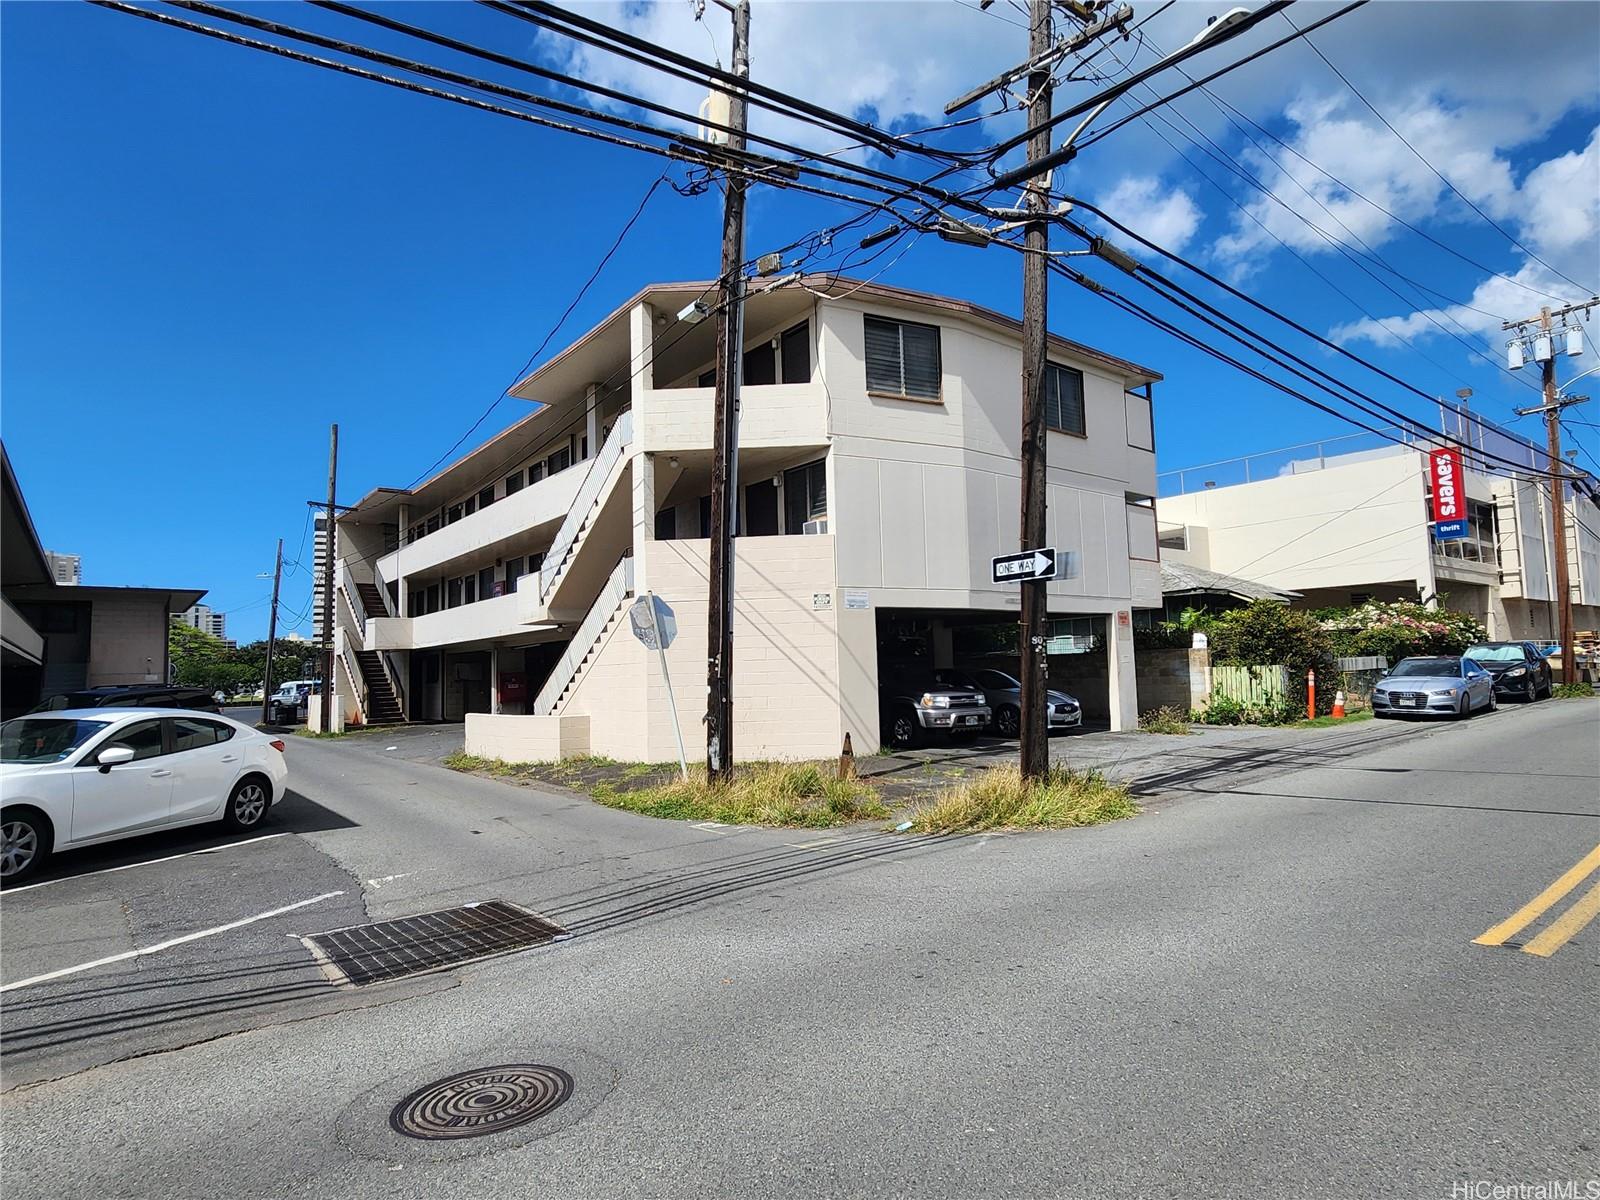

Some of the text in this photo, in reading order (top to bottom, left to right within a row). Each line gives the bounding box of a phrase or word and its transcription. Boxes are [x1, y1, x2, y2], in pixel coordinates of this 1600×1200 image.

[1436, 454, 1456, 515] savers
[1440, 524, 1460, 532] thrift
[998, 560, 1036, 575] ONE WAY
